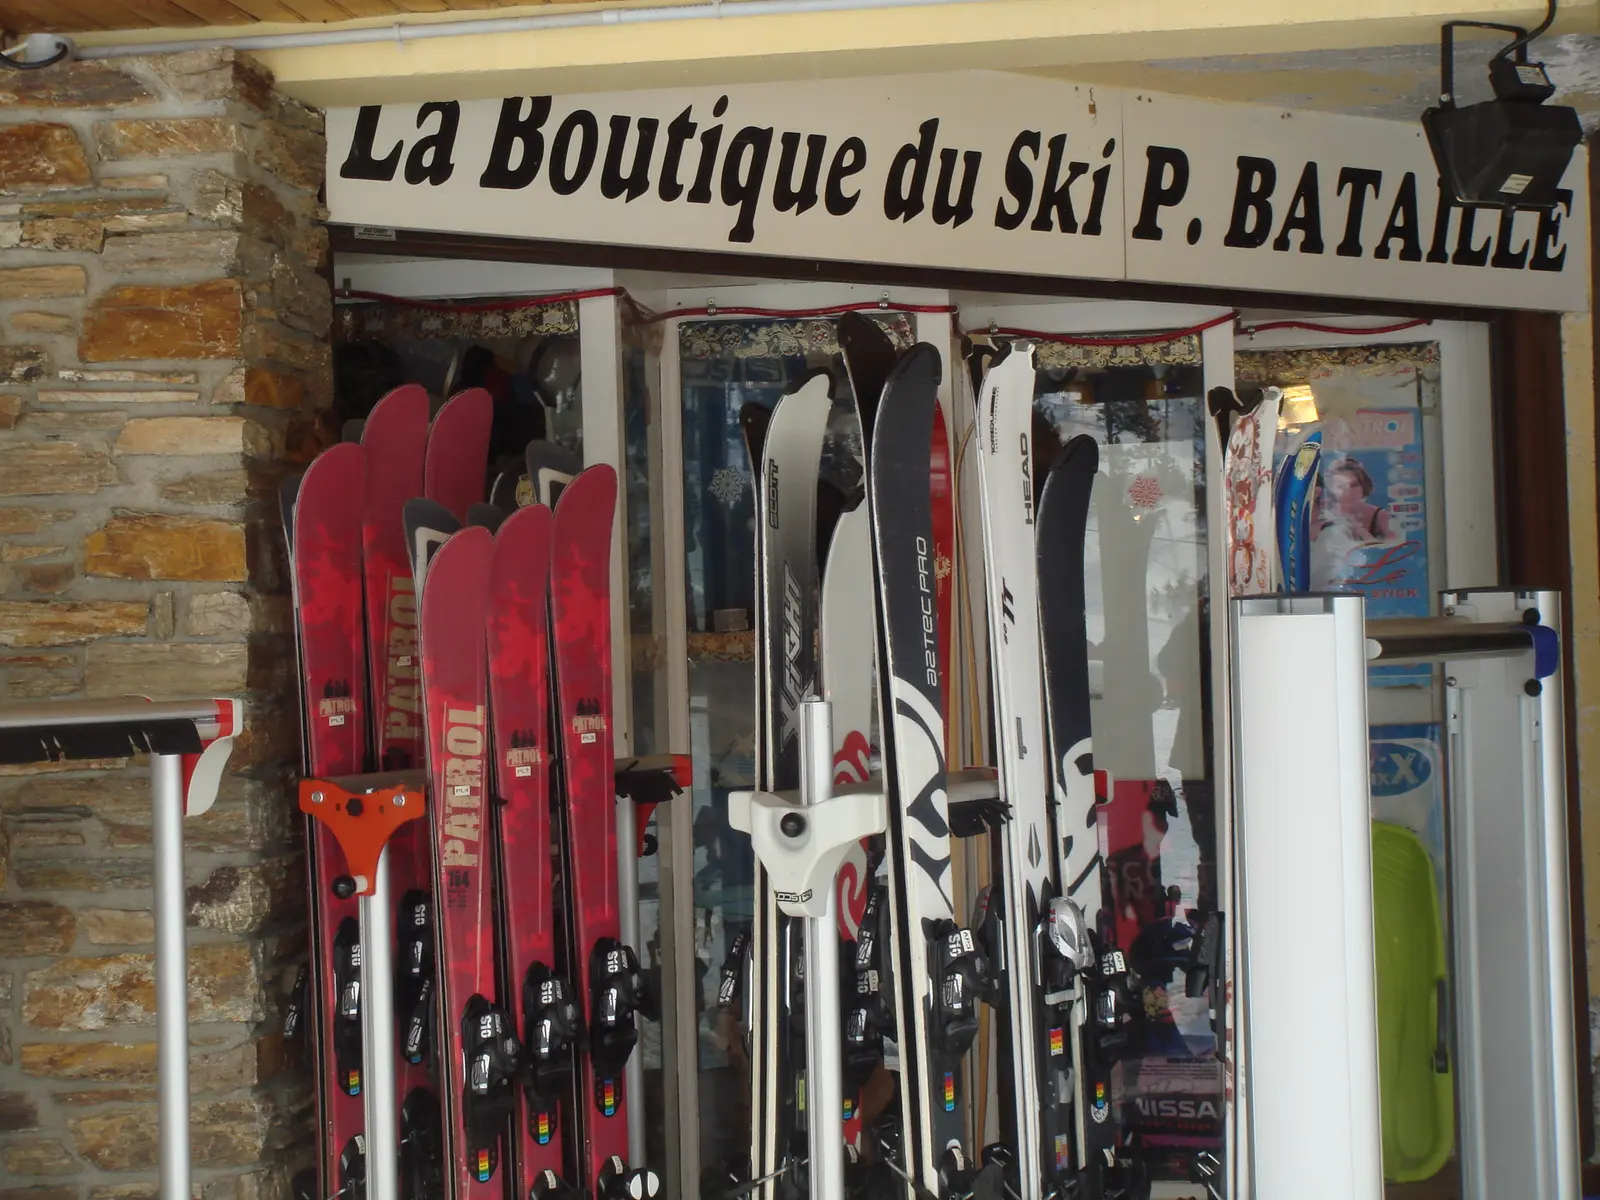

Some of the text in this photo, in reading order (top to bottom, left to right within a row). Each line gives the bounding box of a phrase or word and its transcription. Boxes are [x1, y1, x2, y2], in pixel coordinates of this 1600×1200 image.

[340, 95, 1573, 272] La Boutique du Ski P. BATAILLE
[769, 457, 779, 530] SCOTT
[1020, 432, 1033, 525] HEAD
[916, 536, 930, 593] PRO
[443, 705, 484, 867] PATROL
[481, 1014, 492, 1039] S10
[542, 980, 553, 1004] S10
